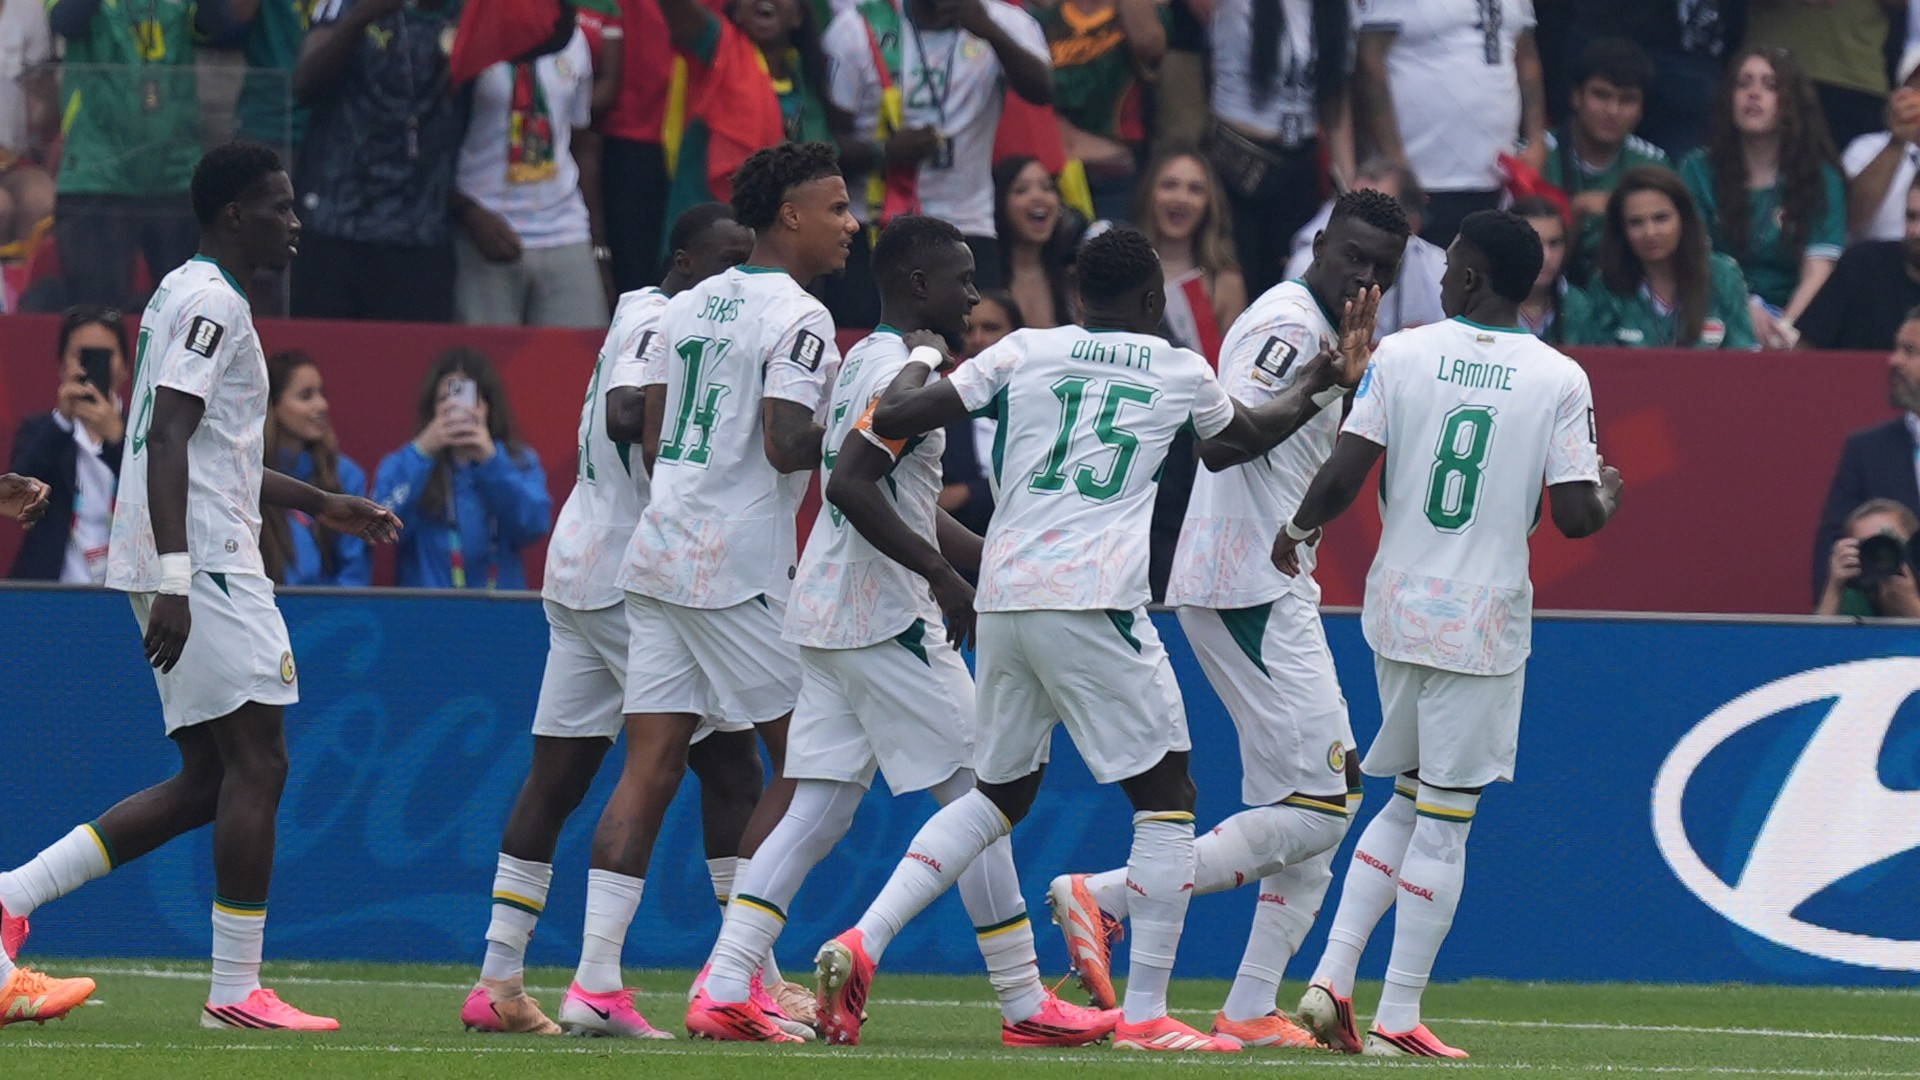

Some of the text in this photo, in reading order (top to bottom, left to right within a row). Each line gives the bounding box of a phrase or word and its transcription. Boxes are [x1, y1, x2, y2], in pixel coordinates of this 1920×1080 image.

[1071, 339, 1152, 371] DIATTA
[1437, 355, 1517, 391] LAMINE
[1027, 375, 1164, 505] 15
[1424, 404, 1498, 535] 8
